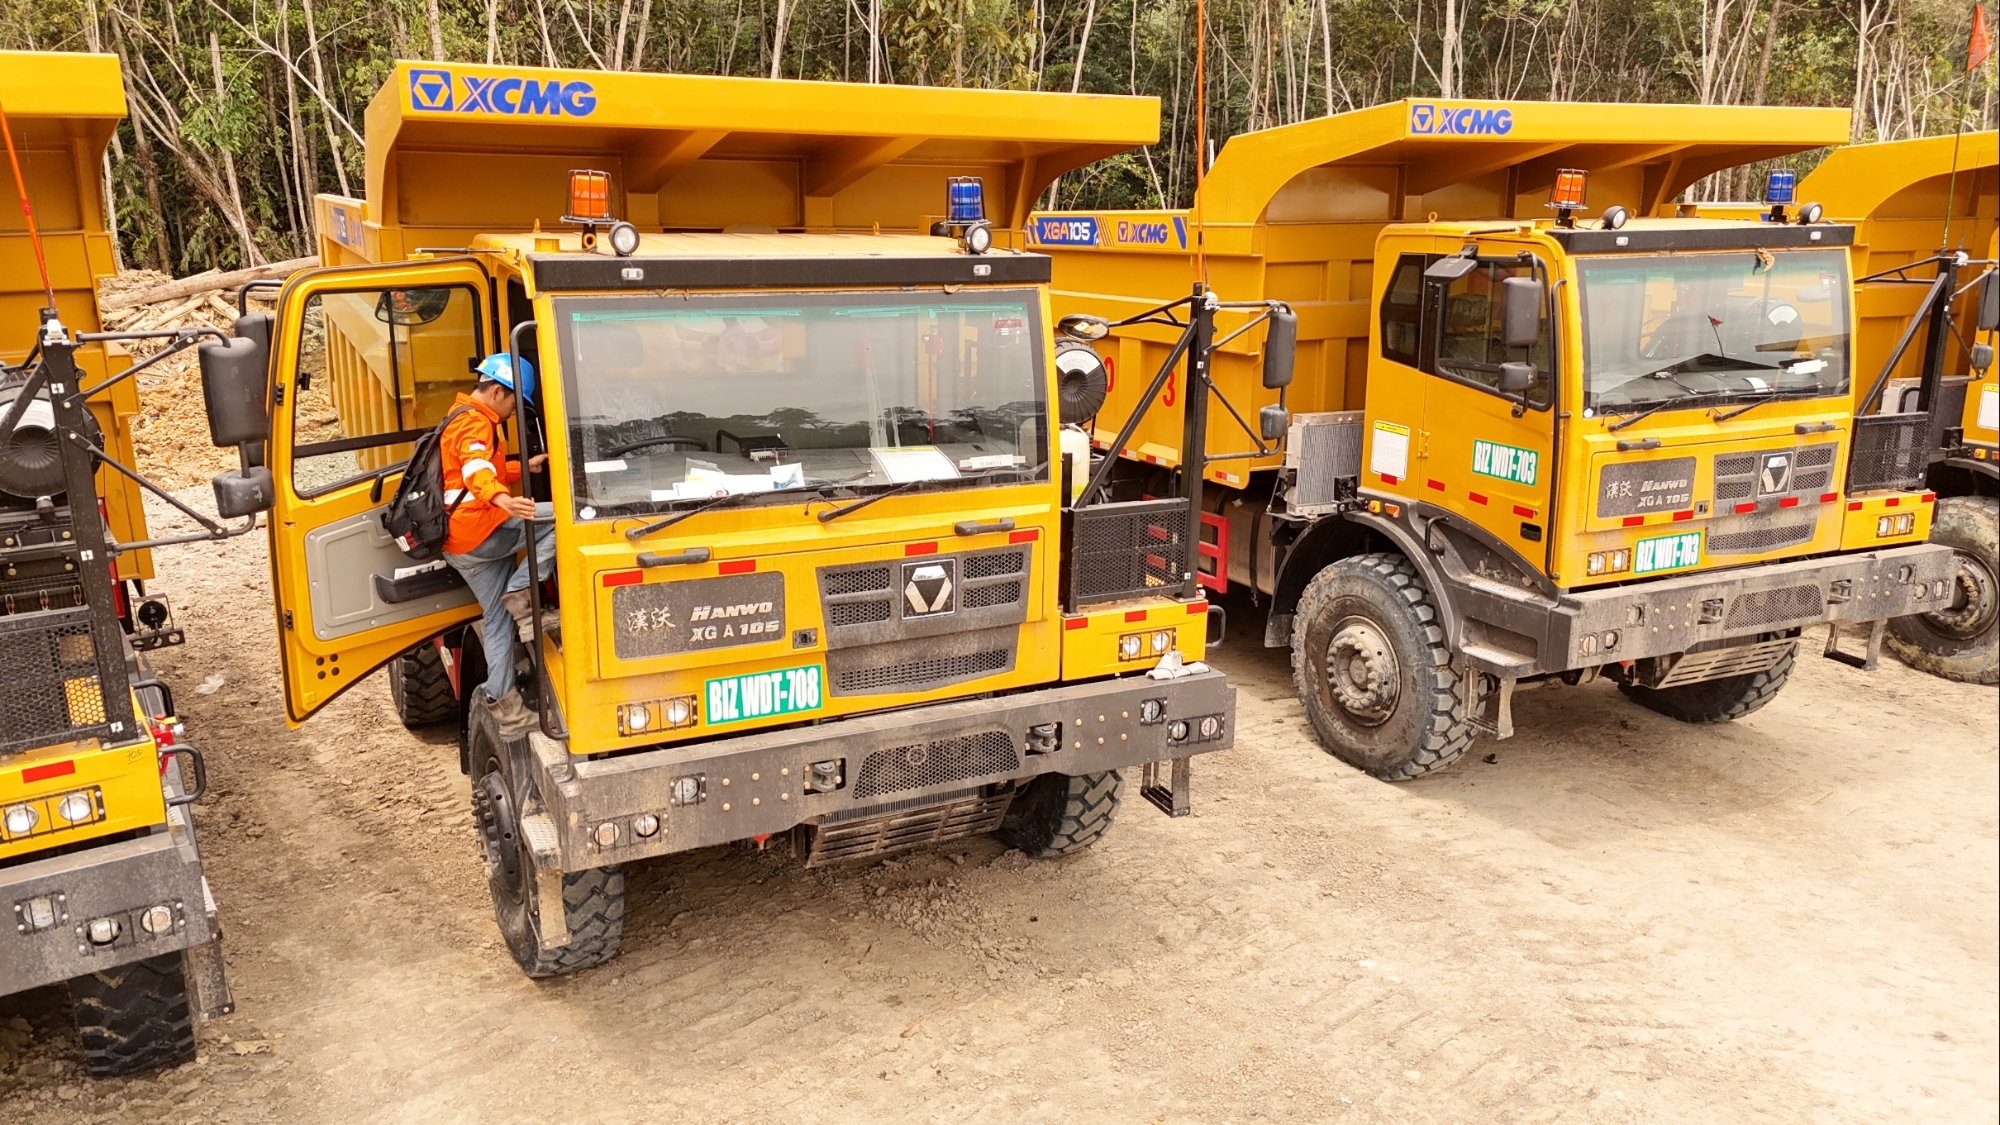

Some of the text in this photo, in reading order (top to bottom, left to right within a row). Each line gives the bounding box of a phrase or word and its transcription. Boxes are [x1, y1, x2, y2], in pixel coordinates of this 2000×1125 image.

[455, 76, 597, 117] XCMG
[1434, 108, 1513, 135] XCMG
[1043, 222, 1091, 241] XGA105
[1129, 223, 1168, 244] XCMG
[1474, 441, 1537, 485] BIZ WDT-703
[1640, 480, 1688, 493] HANWO
[1666, 493, 1690, 504] 105
[1635, 533, 1700, 572] BIZ WDT-703
[626, 606, 676, 632] 漢沃
[690, 602, 773, 622] HANWO
[739, 620, 780, 636] 105
[708, 667, 820, 722] BIZ WDT-708
